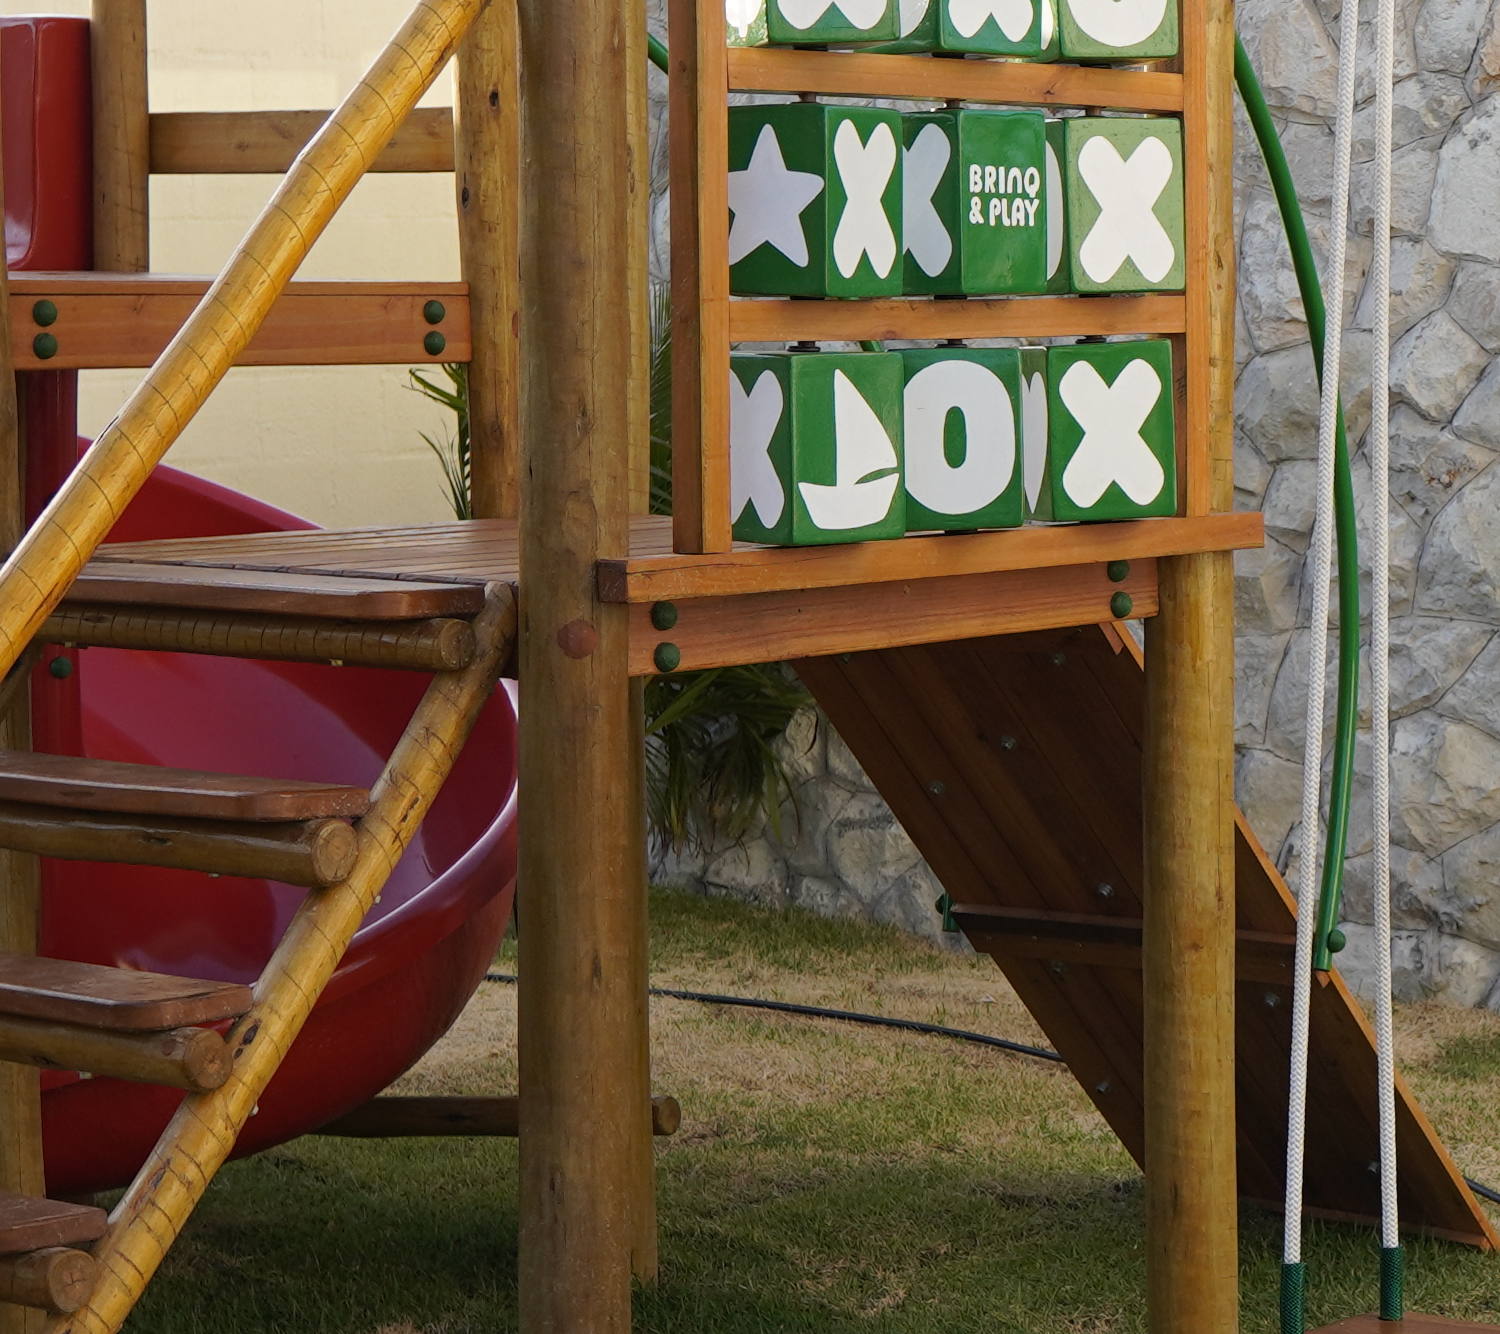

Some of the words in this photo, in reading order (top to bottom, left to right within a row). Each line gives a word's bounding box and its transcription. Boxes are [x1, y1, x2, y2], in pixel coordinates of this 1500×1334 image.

[833, 118, 897, 280] X
[1077, 134, 1175, 285] X
[969, 164, 1040, 198] BRINQ
[969, 196, 984, 225] &
[989, 197, 1040, 227] PLAY
[1059, 358, 1166, 509] X
